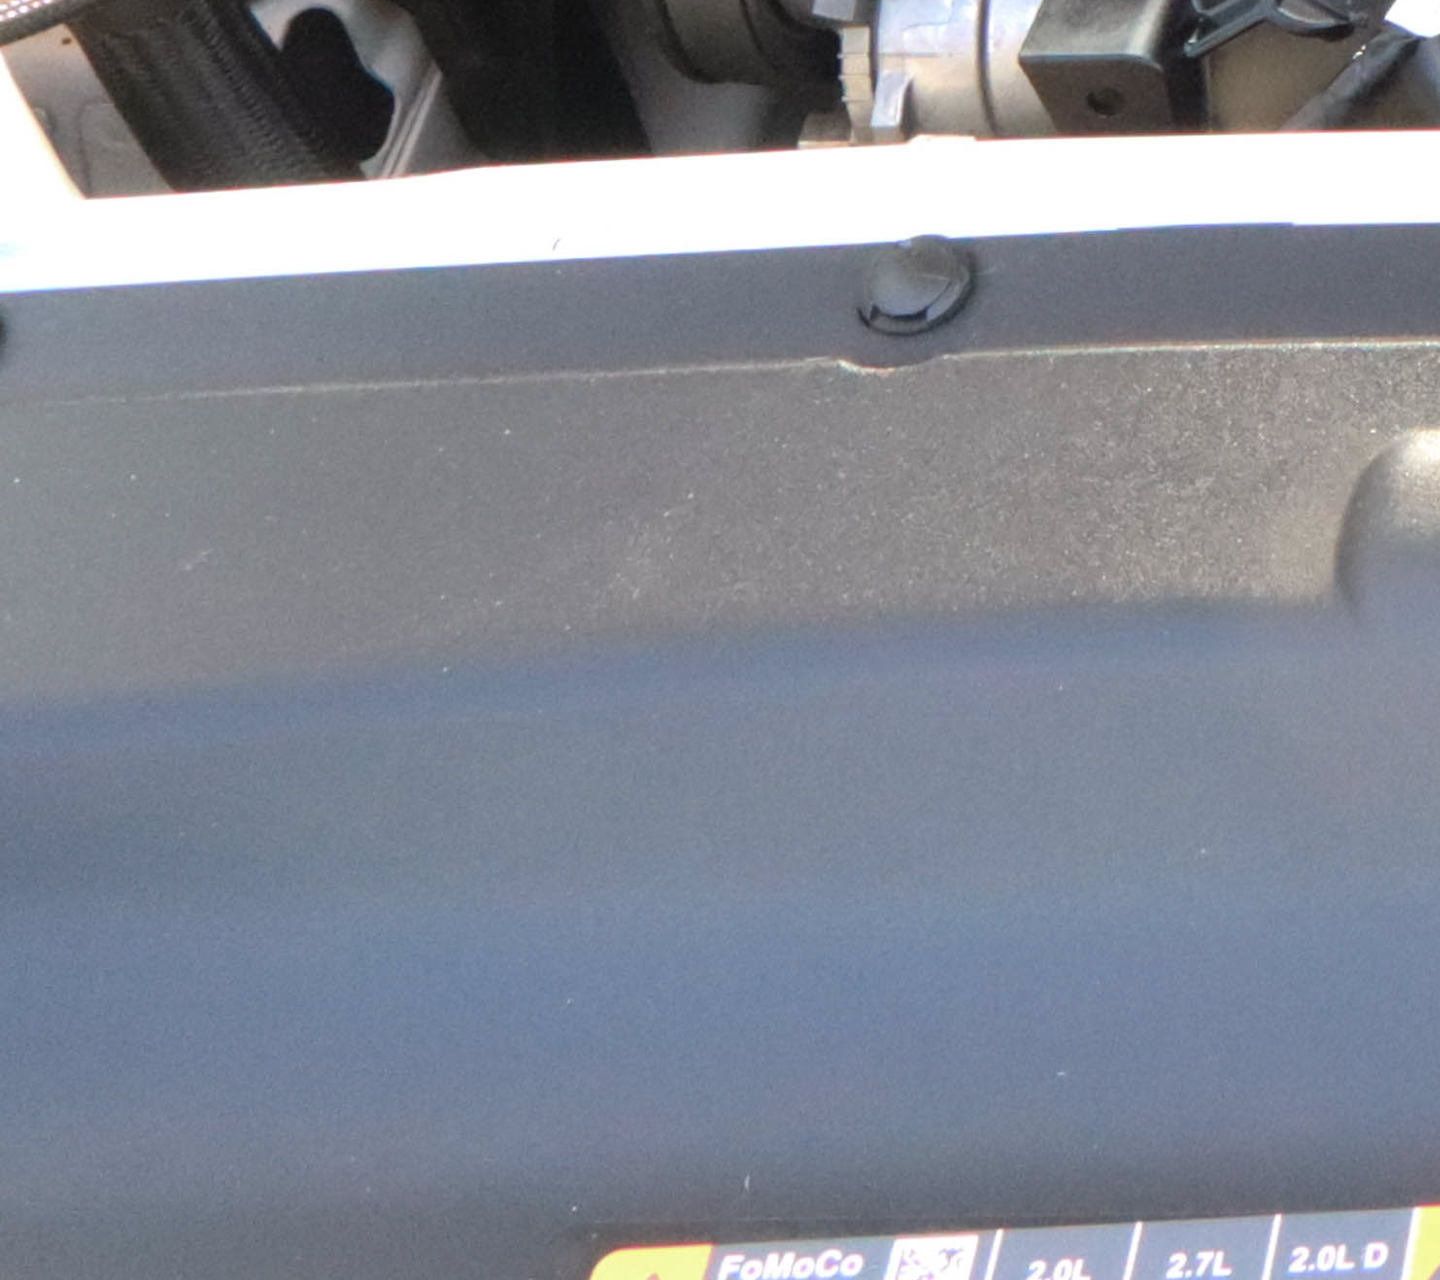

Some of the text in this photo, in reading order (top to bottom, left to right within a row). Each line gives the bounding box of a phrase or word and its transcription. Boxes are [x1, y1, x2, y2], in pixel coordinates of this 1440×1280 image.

[716, 1242, 1390, 1280] FoMoCo 2.0L 2.7L 2.0L D
